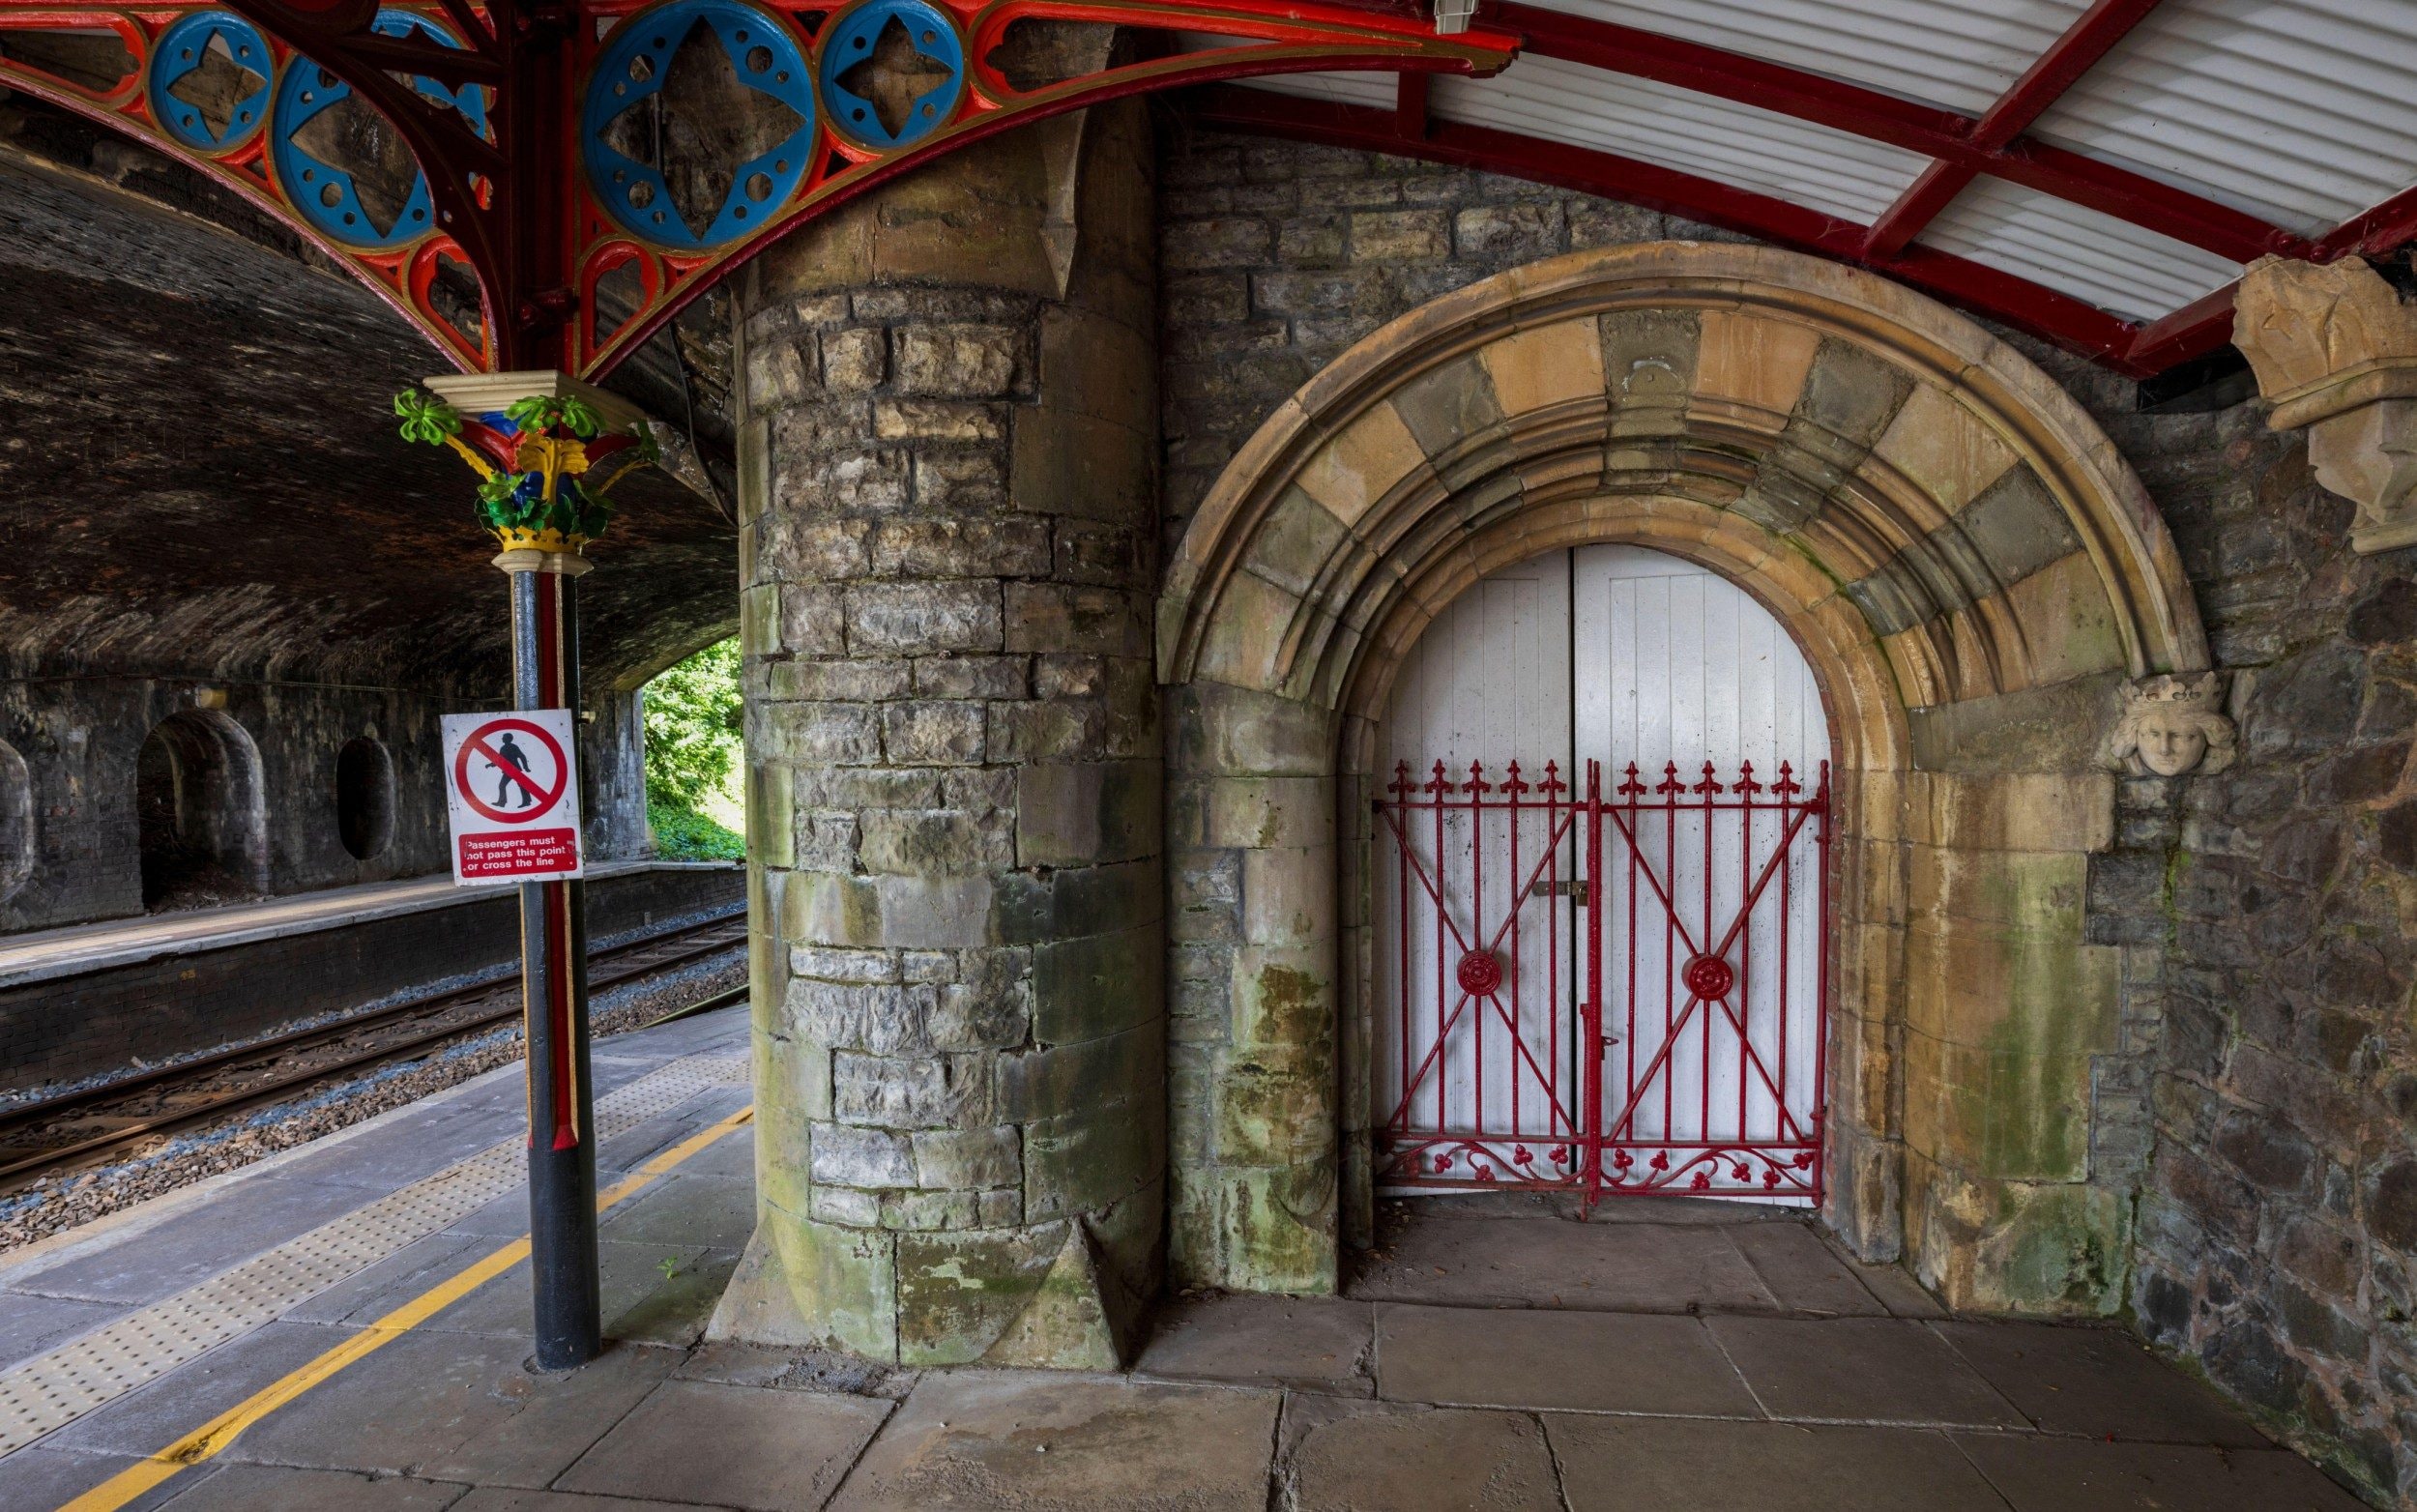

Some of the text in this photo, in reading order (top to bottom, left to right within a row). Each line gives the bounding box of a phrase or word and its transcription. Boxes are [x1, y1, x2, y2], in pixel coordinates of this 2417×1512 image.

[530, 837, 555, 846] must
[466, 851, 483, 860] not
[487, 850, 512, 860] pass
[539, 846, 566, 857] point
[482, 860, 511, 869] cross
